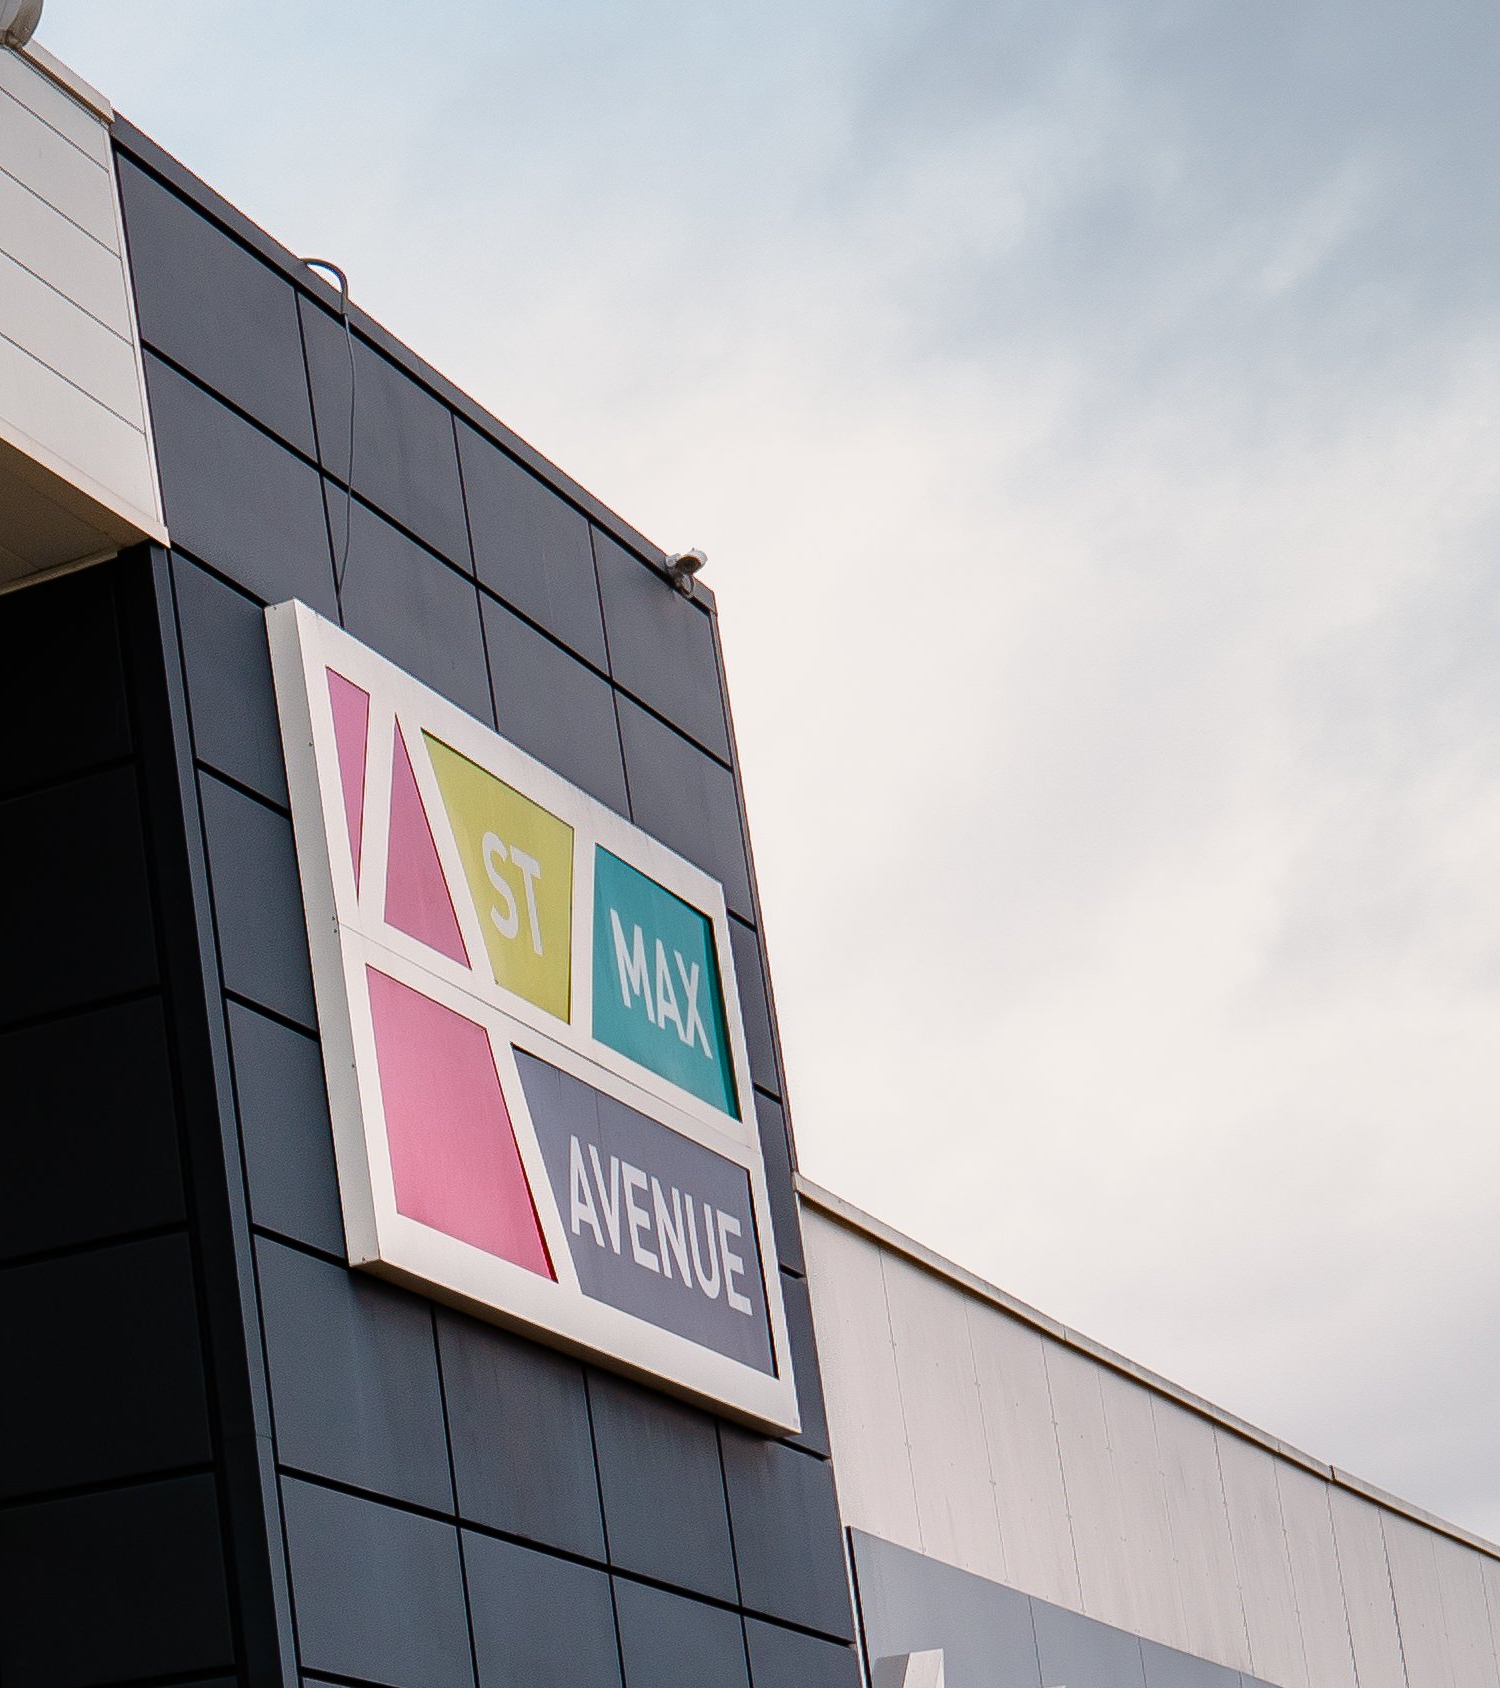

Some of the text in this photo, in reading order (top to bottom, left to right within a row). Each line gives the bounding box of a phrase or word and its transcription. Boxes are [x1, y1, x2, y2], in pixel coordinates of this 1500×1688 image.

[481, 831, 713, 1060] ST MAX
[569, 1135, 754, 1318] AVENUE
